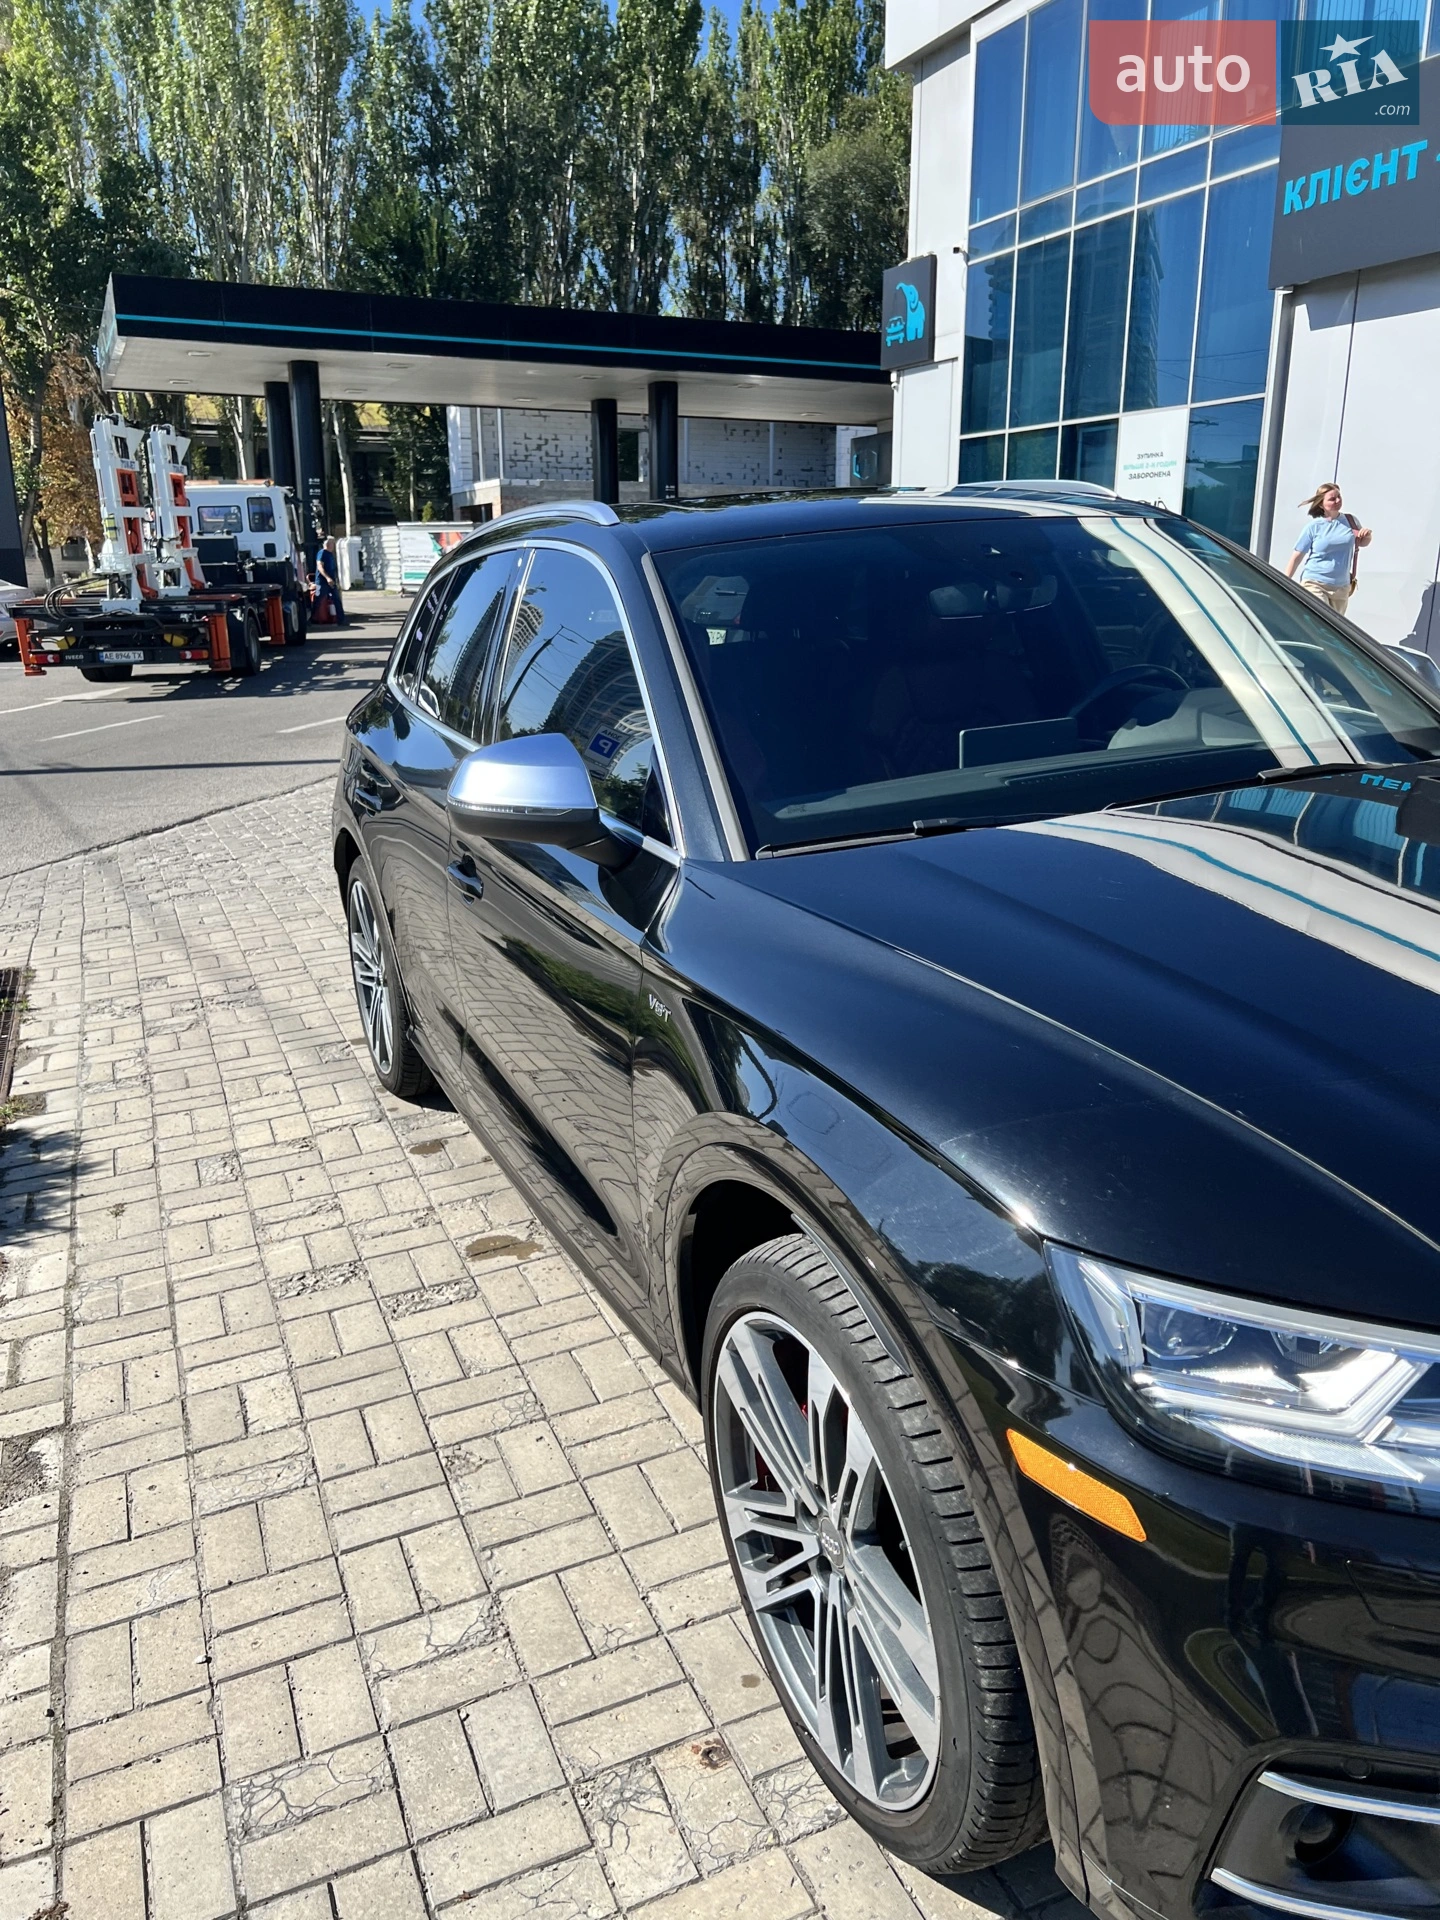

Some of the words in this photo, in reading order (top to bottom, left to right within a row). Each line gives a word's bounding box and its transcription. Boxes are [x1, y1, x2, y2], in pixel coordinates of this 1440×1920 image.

[1283, 139, 1428, 216] КЛІЄНТ
[1137, 451, 1164, 460] ЗУПИНКА
[1128, 470, 1171, 480] ЗАБОРОНЕНА
[104, 652, 114, 660] AE
[648, 993, 672, 1023] V6T
